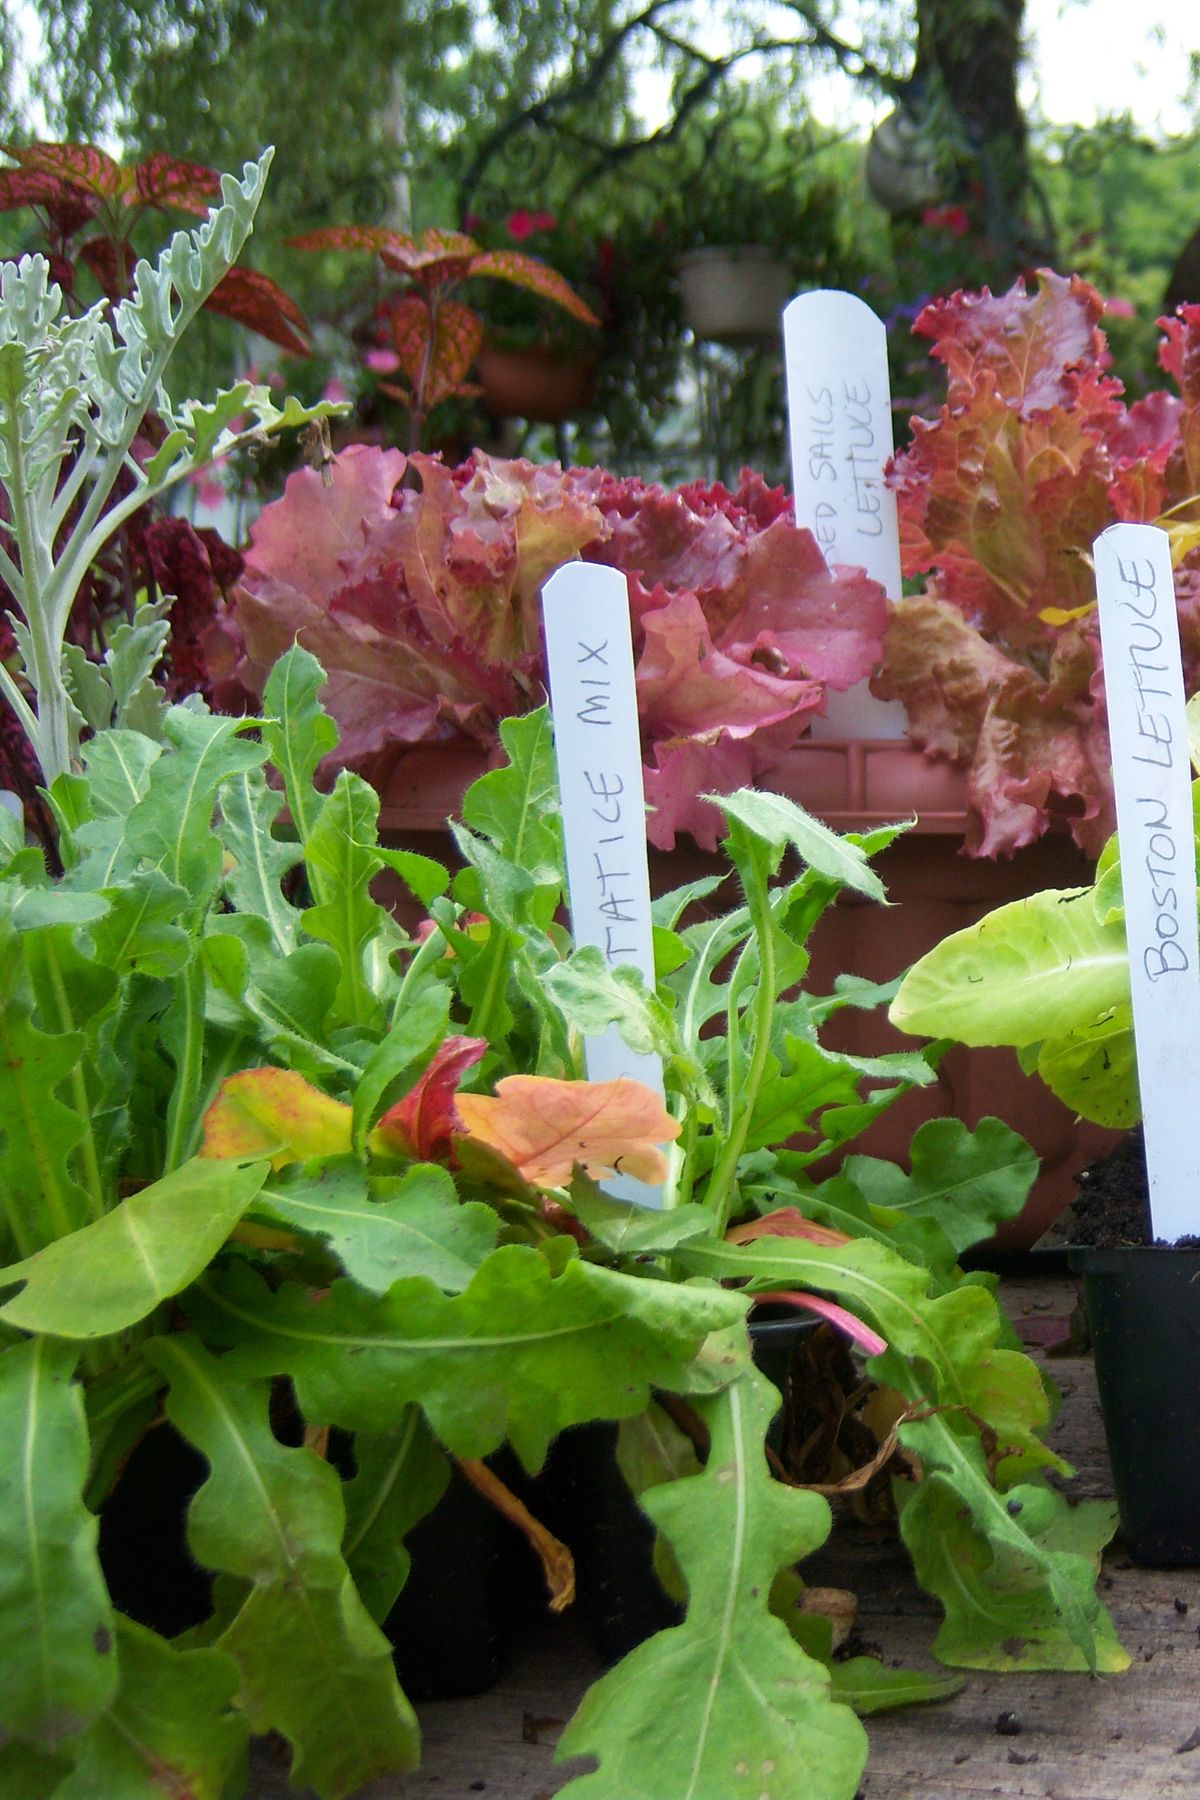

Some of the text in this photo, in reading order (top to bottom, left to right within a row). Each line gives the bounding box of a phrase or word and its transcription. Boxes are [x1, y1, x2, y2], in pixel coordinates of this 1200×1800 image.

[807, 386, 838, 482] SAILS
[843, 378, 882, 537] LETTUCE
[577, 639, 638, 963] TATICE MIX
[1117, 557, 1189, 982] BOSTON LETTUCE
